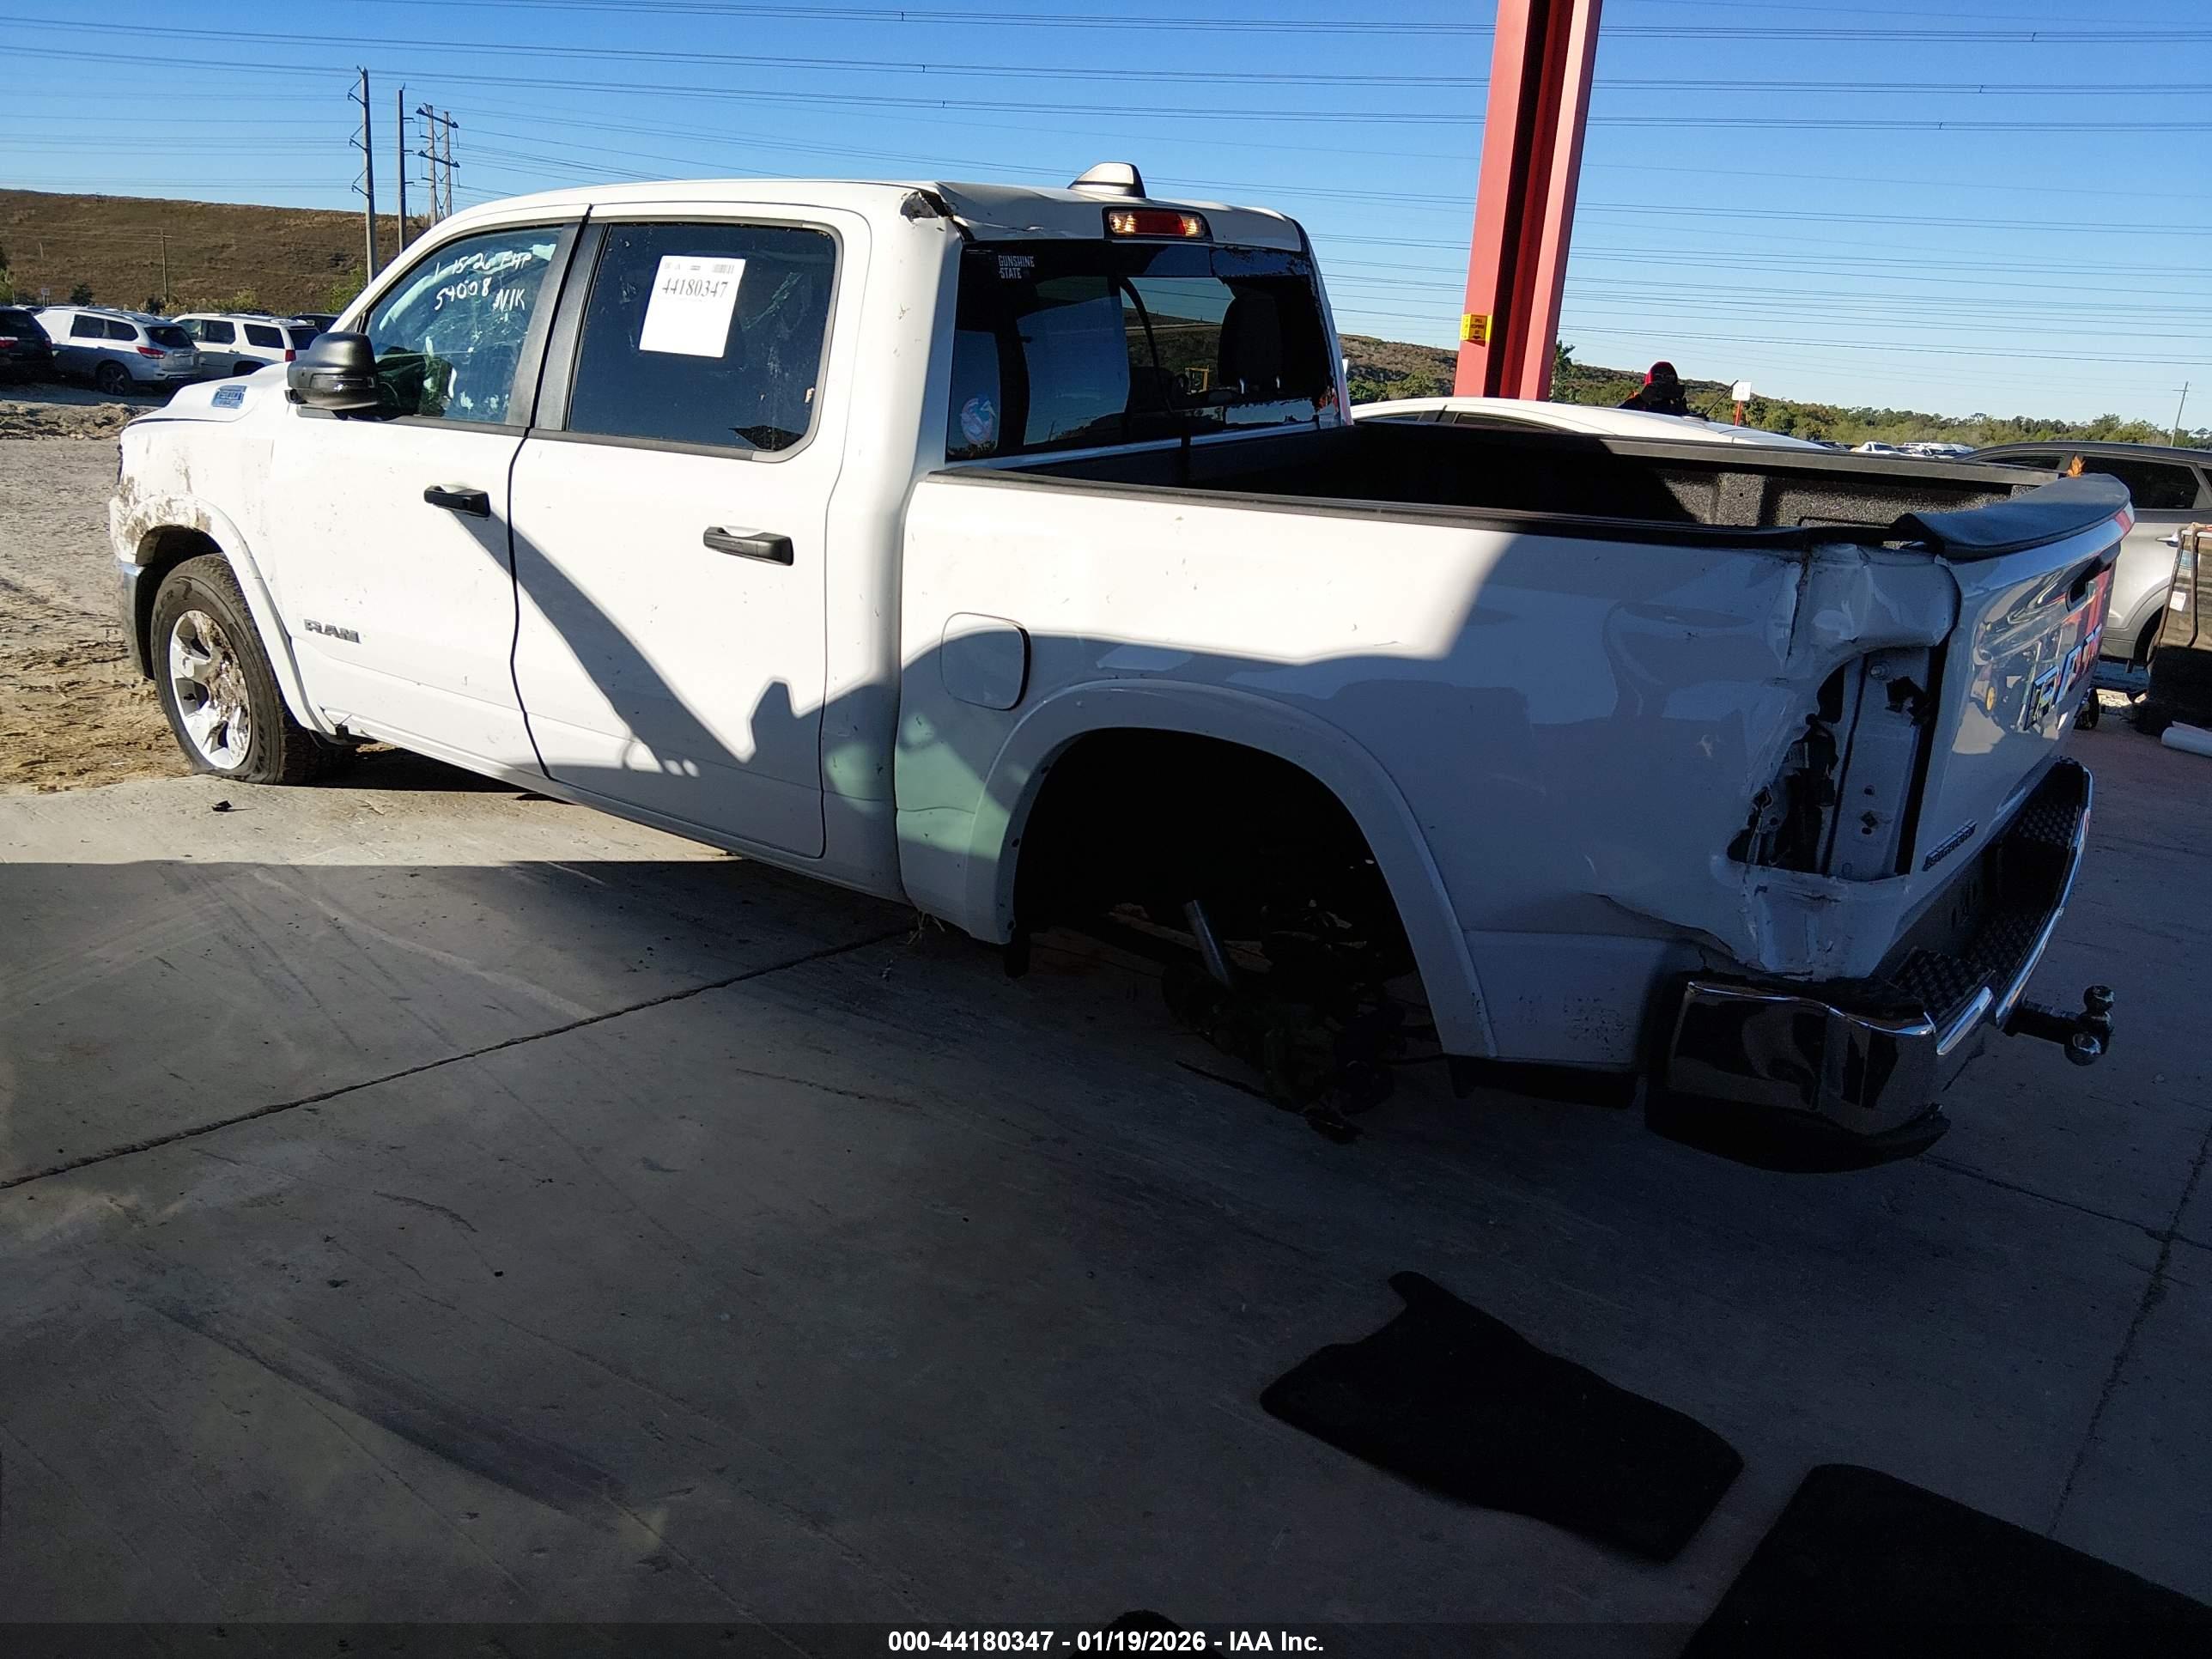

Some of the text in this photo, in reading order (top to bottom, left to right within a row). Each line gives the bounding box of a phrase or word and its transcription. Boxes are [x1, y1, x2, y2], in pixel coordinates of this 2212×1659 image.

[999, 267, 1022, 279] STATE
[662, 277, 729, 298] 44180347
[304, 618, 361, 644] RAM
